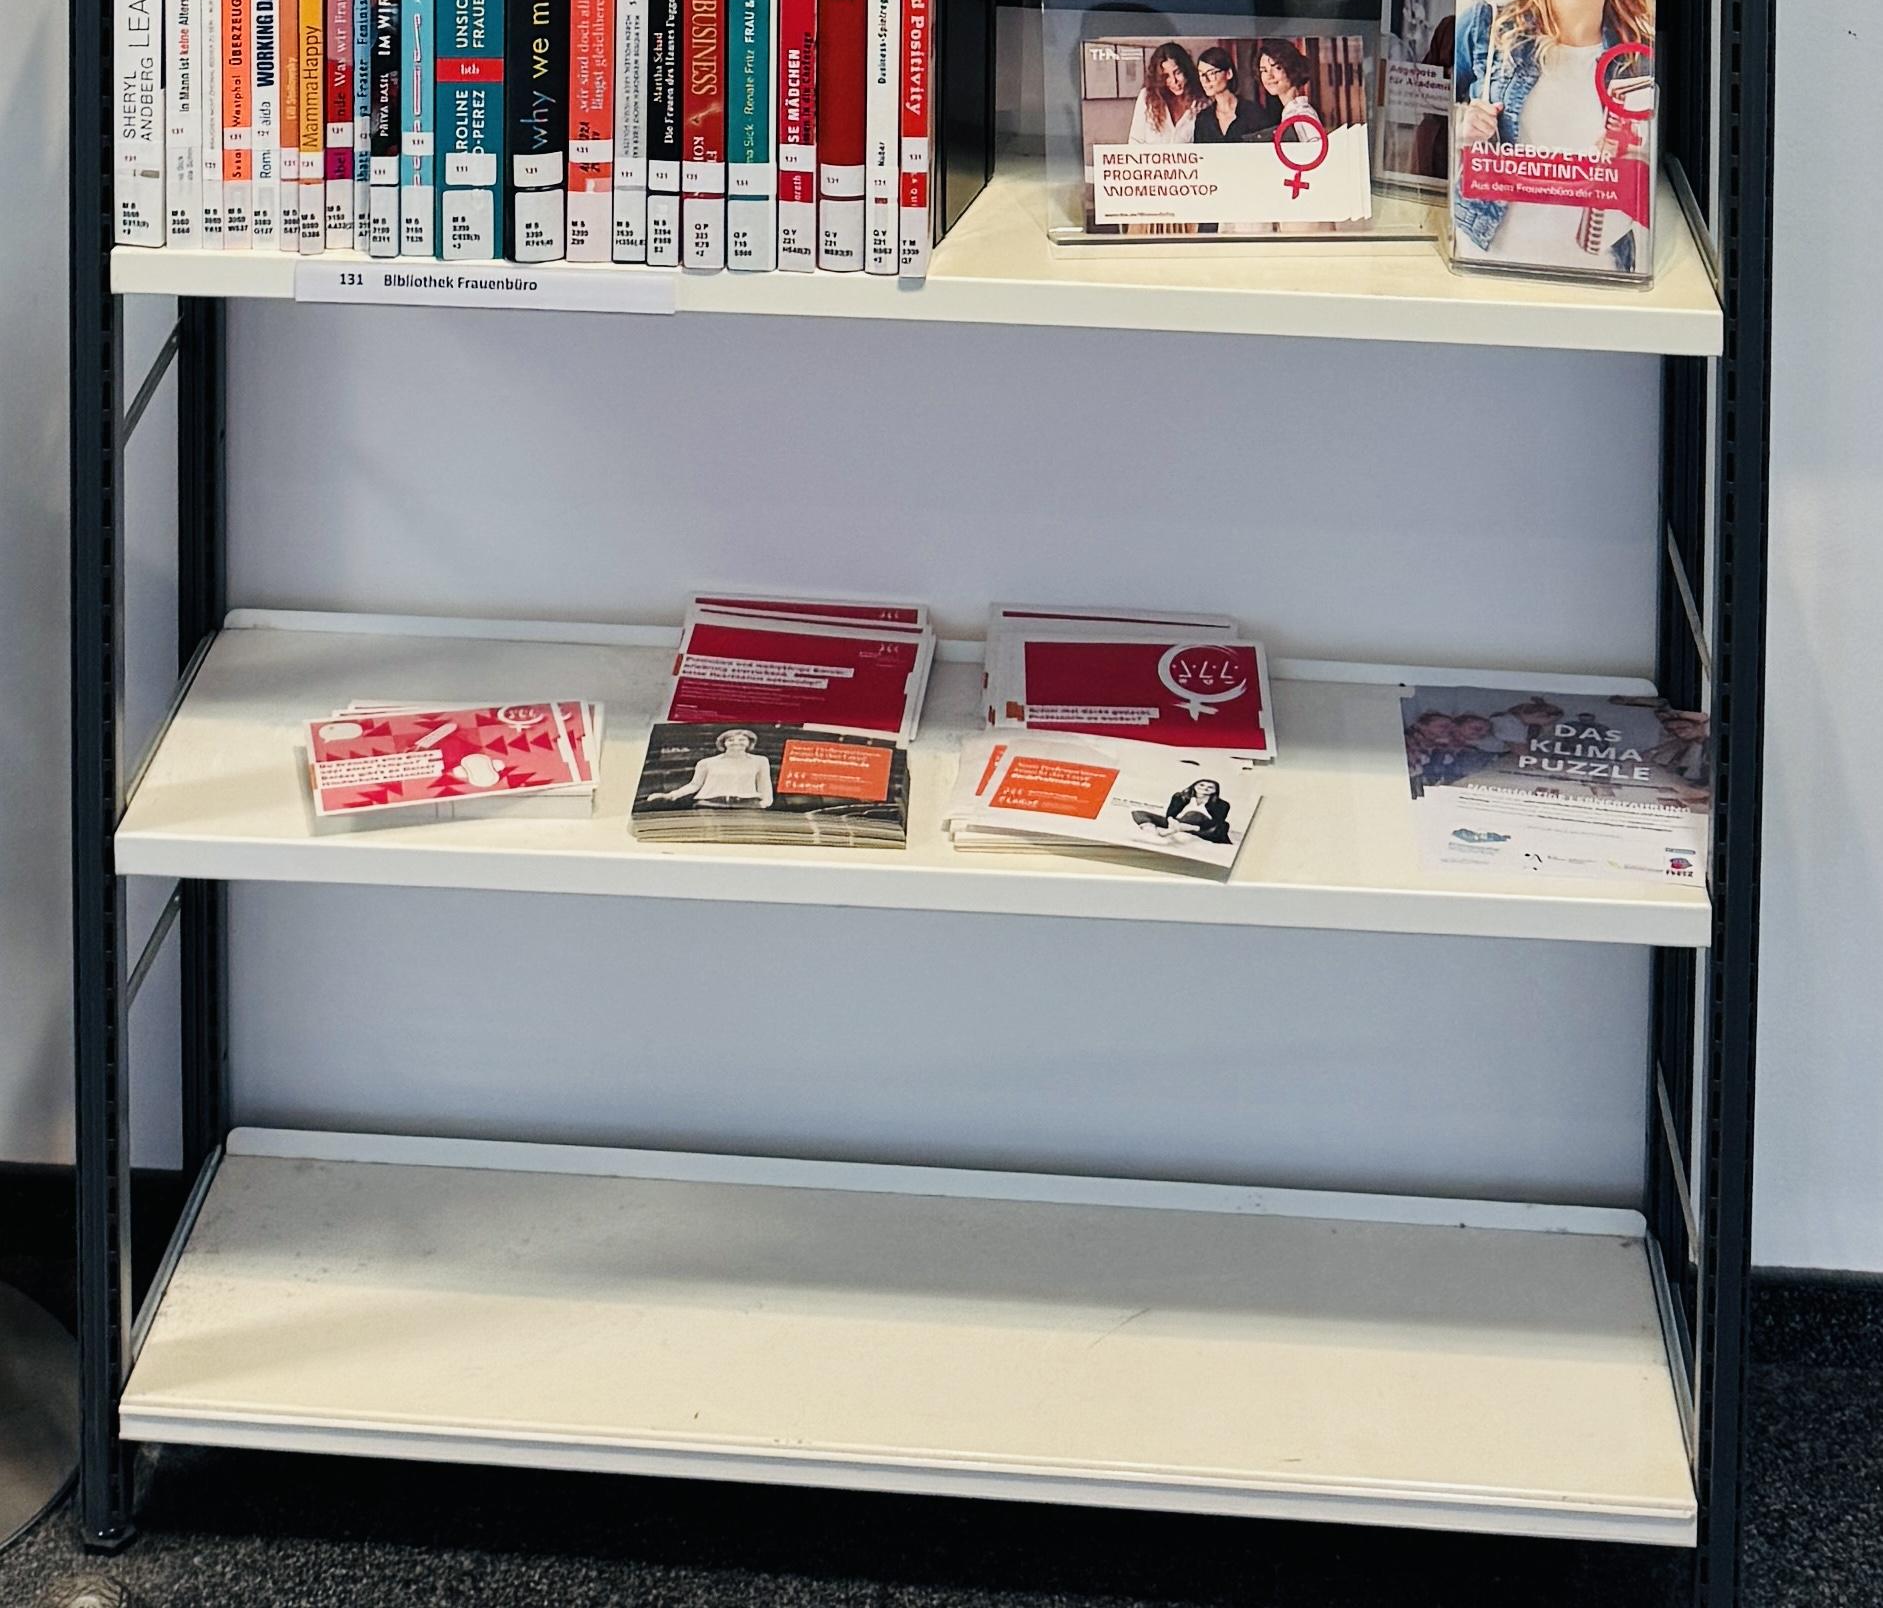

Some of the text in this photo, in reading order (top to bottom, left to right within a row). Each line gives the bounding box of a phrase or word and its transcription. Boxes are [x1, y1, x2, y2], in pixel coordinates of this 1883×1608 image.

[744, 11, 756, 43] FRAU
[257, 15, 274, 88] WORKING
[527, 37, 549, 79] we
[691, 0, 718, 95] BUSINESS
[904, 16, 925, 115] Positivity
[786, 49, 801, 121] MÄDCHEN
[122, 71, 137, 139] SHERYL
[521, 91, 556, 149] why
[1102, 152, 1204, 165] MENTORING-
[1103, 169, 1198, 181] PROGRAMM
[1104, 184, 1218, 197] WOMENGOTOP
[339, 274, 538, 291] 131 Bibliothek Frauenbüro
[1554, 724, 1622, 742] DAS
[1530, 739, 1643, 762] KLIMA
[1519, 755, 1651, 781] PUZZLE
